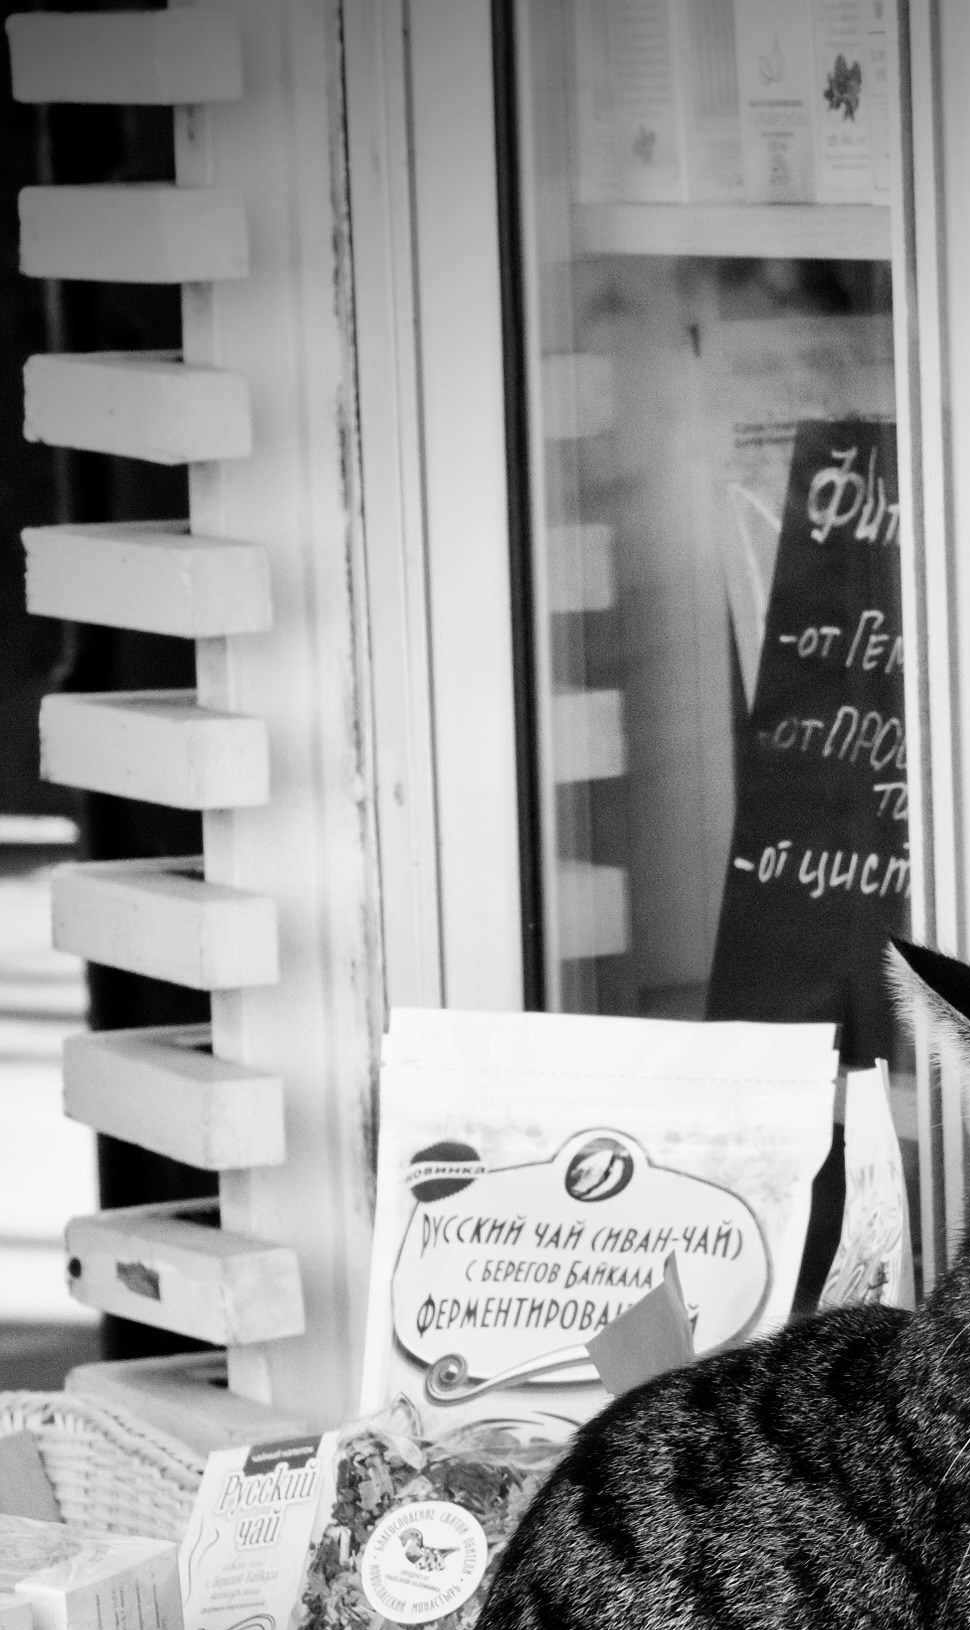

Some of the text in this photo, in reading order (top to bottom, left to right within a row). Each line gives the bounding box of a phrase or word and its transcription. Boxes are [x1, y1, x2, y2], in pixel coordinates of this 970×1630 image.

[421, 1212, 527, 1260] РУССКИЙ
[534, 1218, 585, 1252] ЧАЙ
[480, 1259, 559, 1284] БЕРЕГОВ
[220, 1463, 317, 1516] Русский
[239, 1507, 281, 1546] чай
